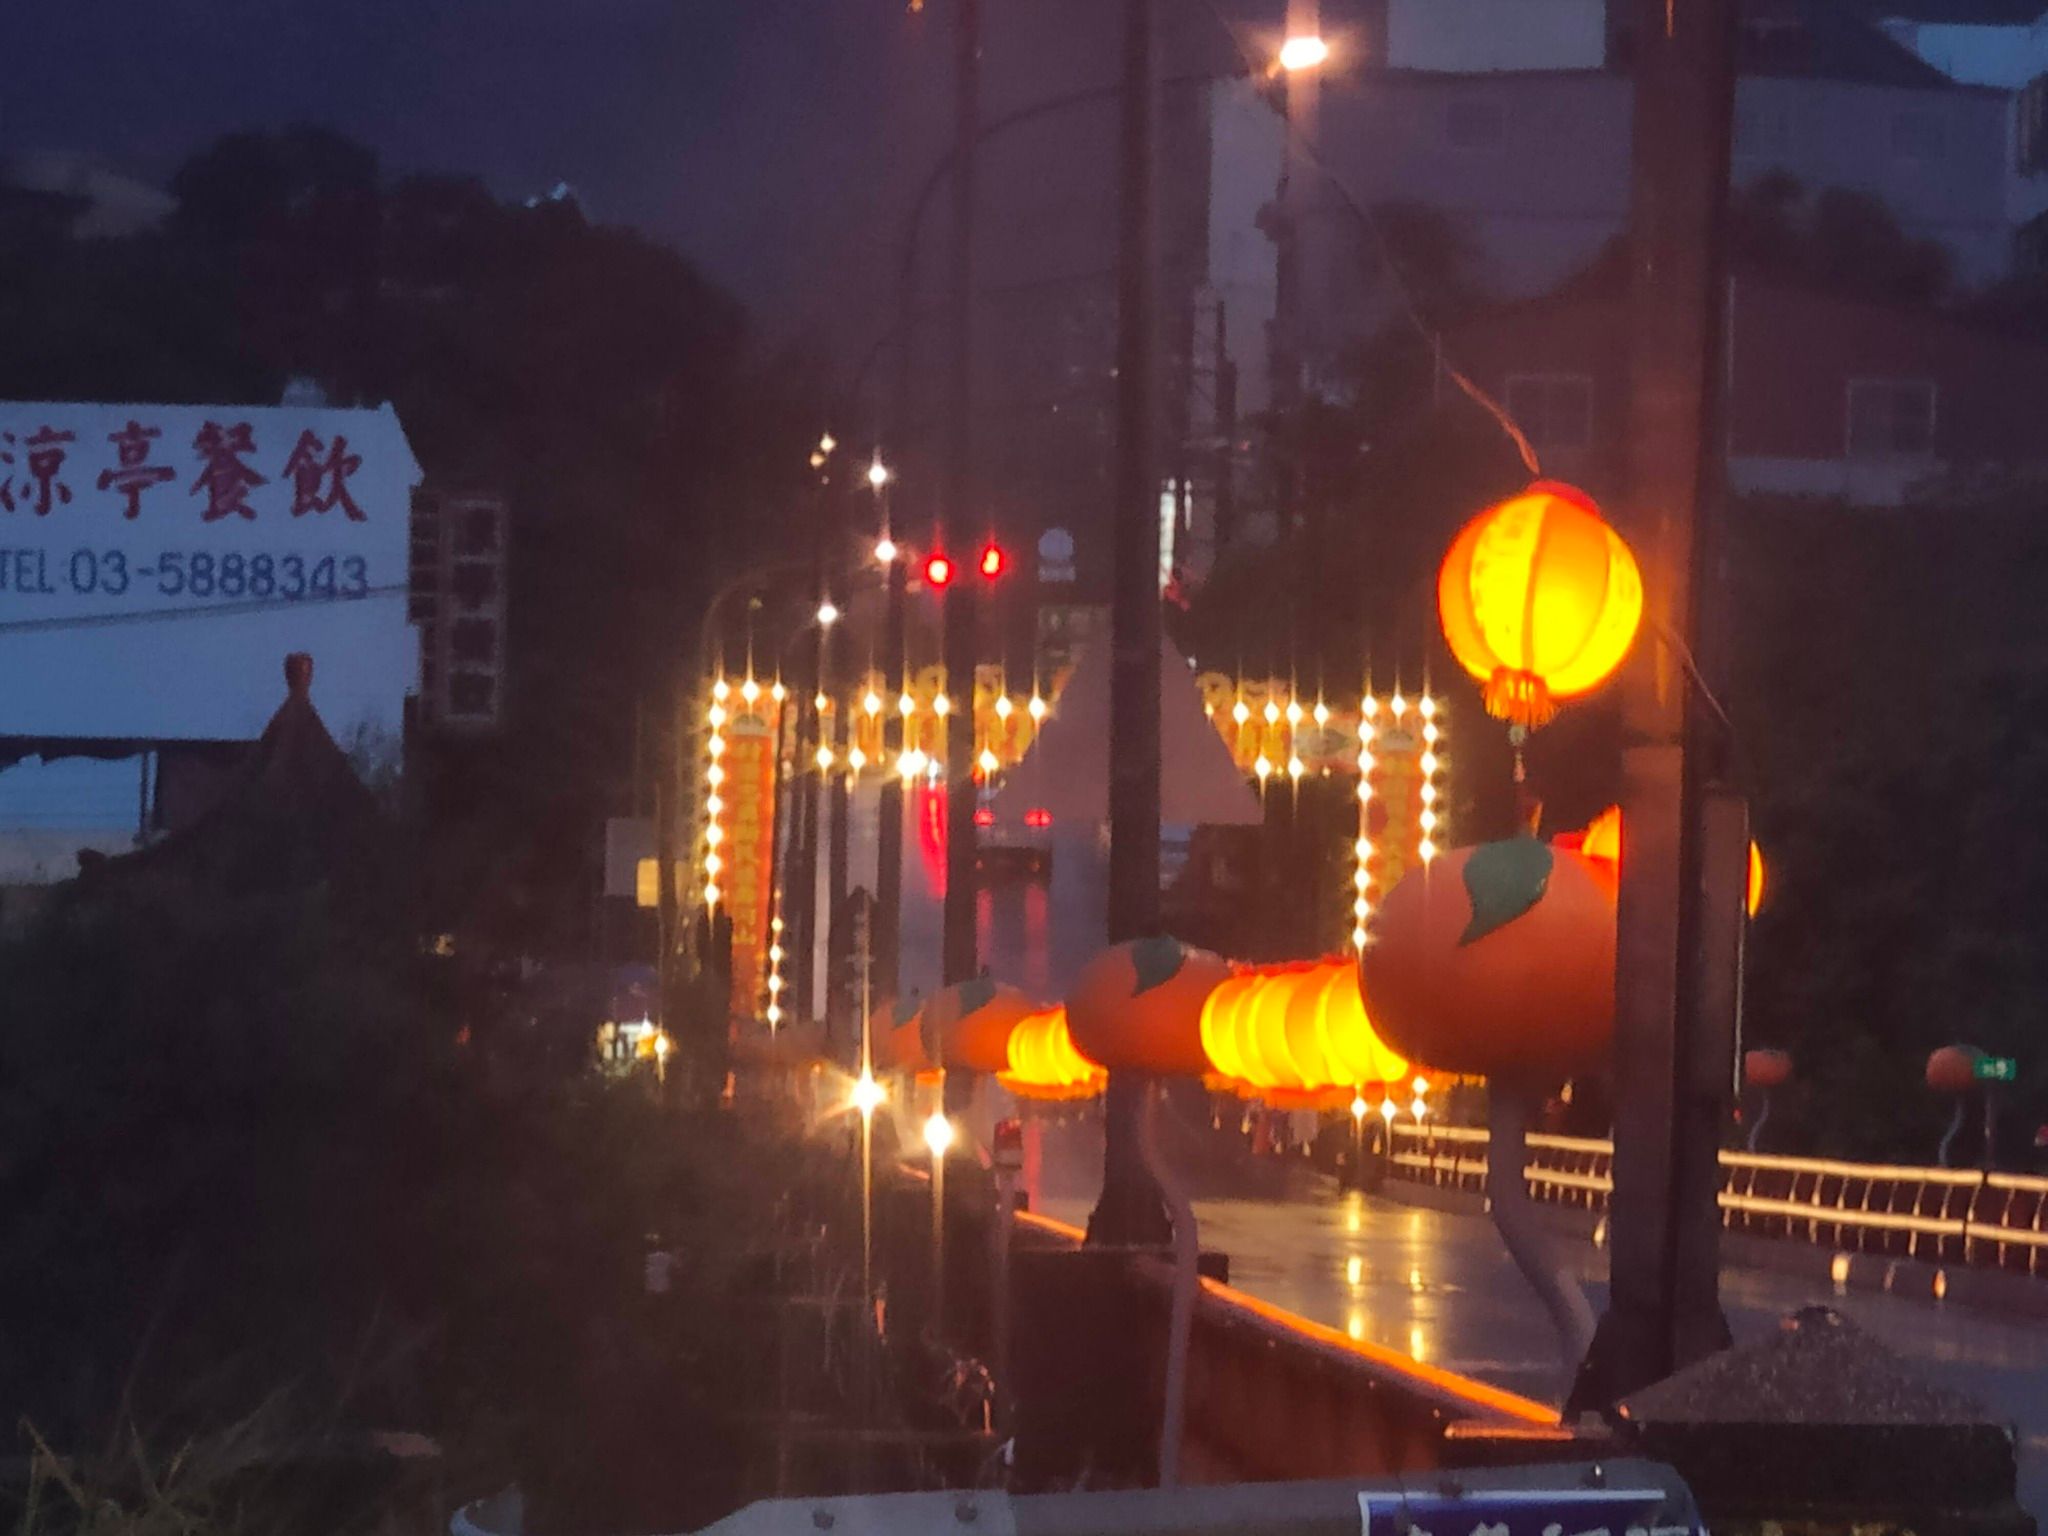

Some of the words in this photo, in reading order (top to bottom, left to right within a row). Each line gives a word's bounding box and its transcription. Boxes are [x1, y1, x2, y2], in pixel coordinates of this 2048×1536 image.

[0, 420, 368, 523] 涼亭餐飲
[70, 548, 368, 601] 03-5888343
